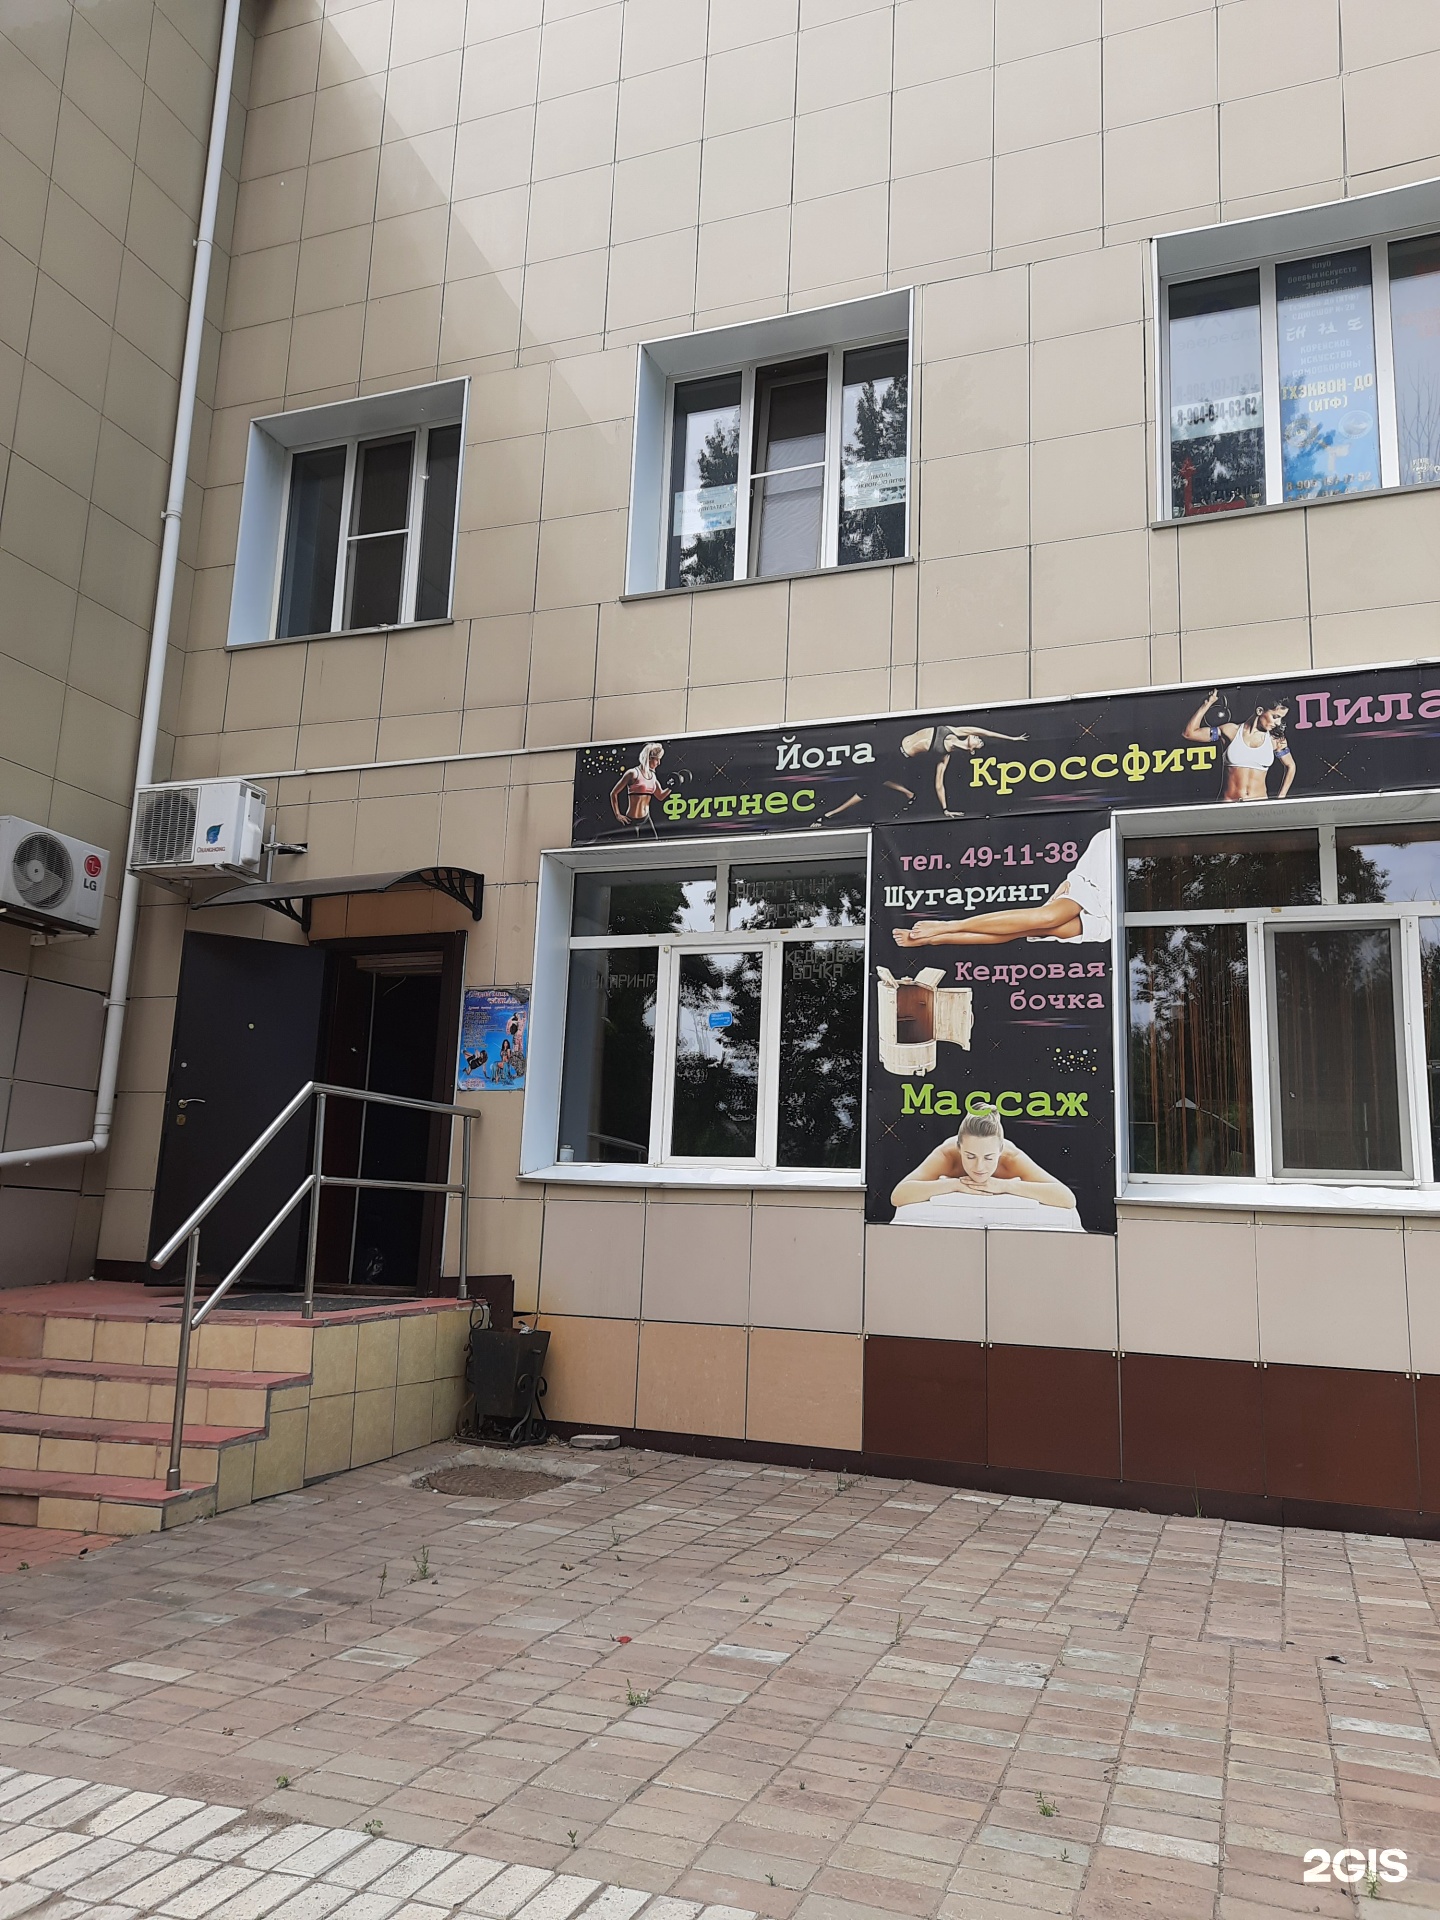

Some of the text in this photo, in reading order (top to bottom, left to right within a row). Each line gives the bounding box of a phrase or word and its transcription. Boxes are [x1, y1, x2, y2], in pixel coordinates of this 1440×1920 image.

[1301, 350, 1352, 366] ИСКУССТВО
[1308, 394, 1348, 413] (ИТФ)
[775, 735, 875, 771] Йога
[969, 744, 1217, 795] Кроссфит
[662, 789, 815, 821] Фитнес
[900, 841, 1078, 871] тел. 49-11-38
[83, 878, 97, 891] LG
[884, 883, 1049, 910] Шугаринг
[793, 963, 843, 980] БОЧКА
[955, 961, 1106, 985] Кедровая
[1009, 989, 1105, 1011] бочка
[900, 1083, 1089, 1117] Массаж
